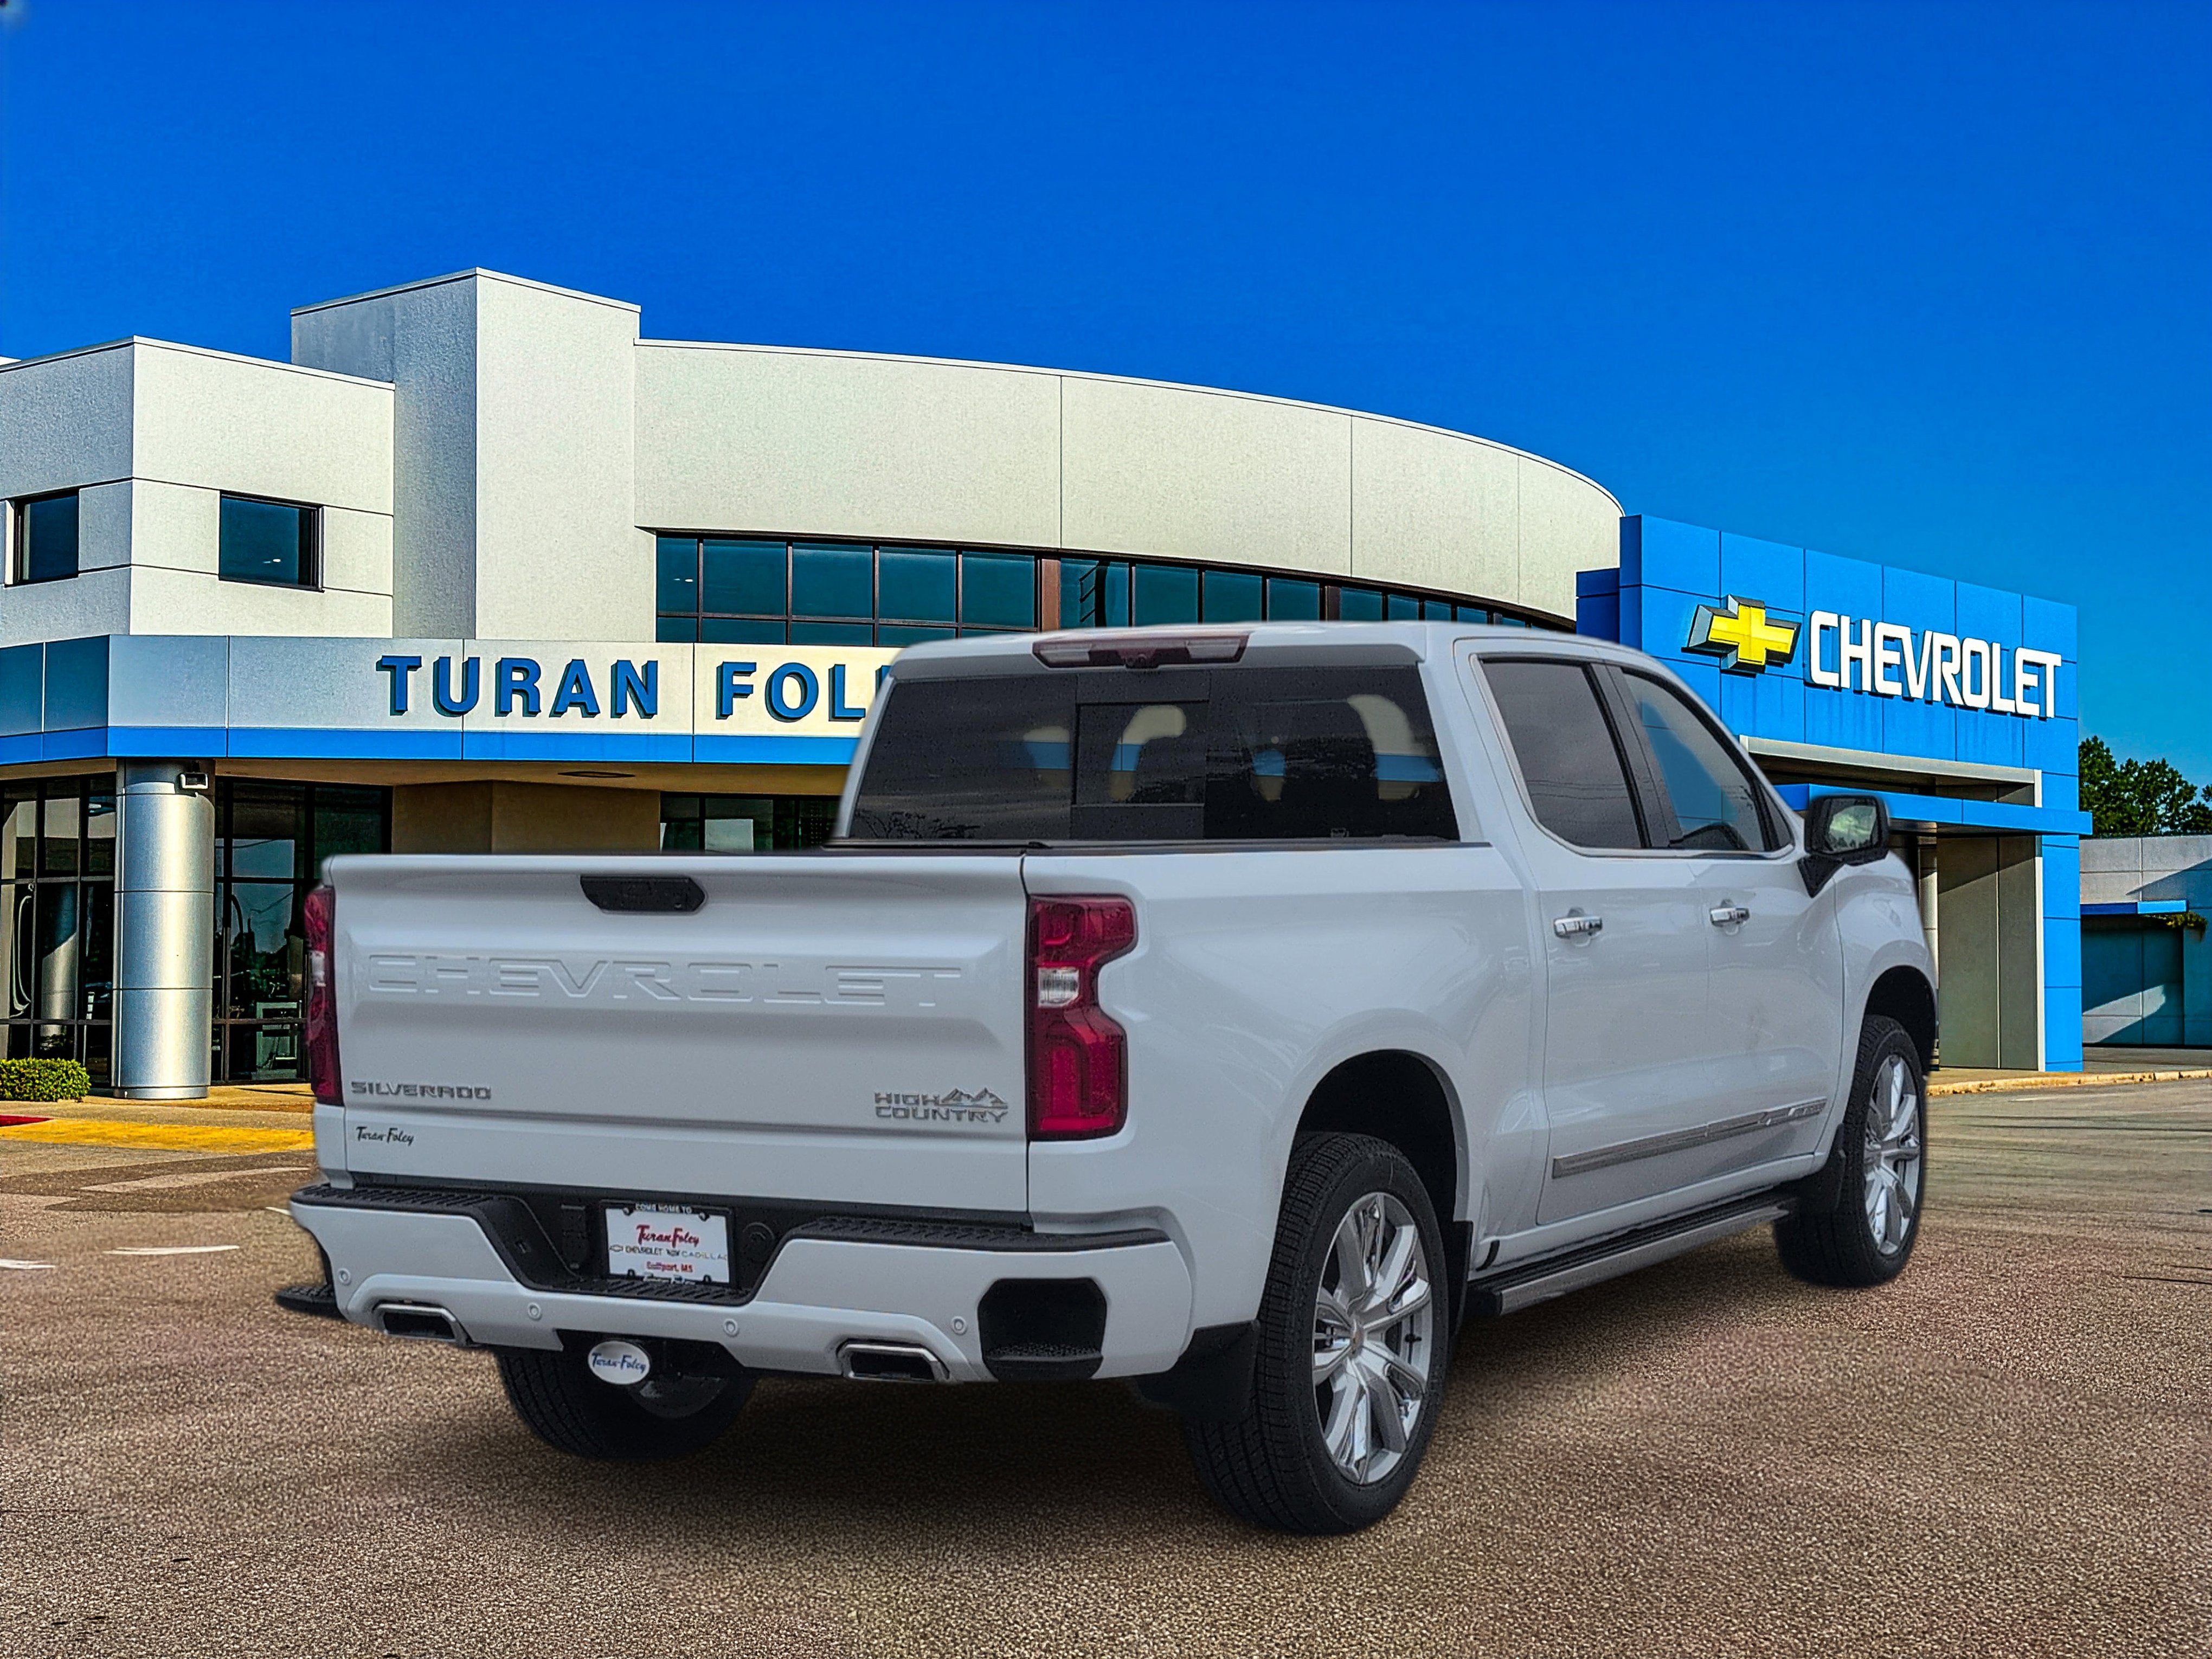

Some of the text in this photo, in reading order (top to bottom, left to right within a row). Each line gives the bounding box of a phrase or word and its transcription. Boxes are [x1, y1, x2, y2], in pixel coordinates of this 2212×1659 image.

[1808, 610, 2062, 719] CHEVROLET
[376, 655, 891, 722] TURAN FOL
[369, 955, 961, 1007] CHEVROLET
[351, 1081, 491, 1100] SILVERADO
[874, 1092, 940, 1105] HIGH
[874, 1105, 1008, 1123] COUNTRY
[356, 1126, 414, 1146] Turan Foley
[681, 1206, 692, 1214] TO
[636, 1224, 699, 1248] Turan Foley
[681, 1250, 728, 1261] CADILLAC
[591, 1352, 647, 1374] Turan Foley
